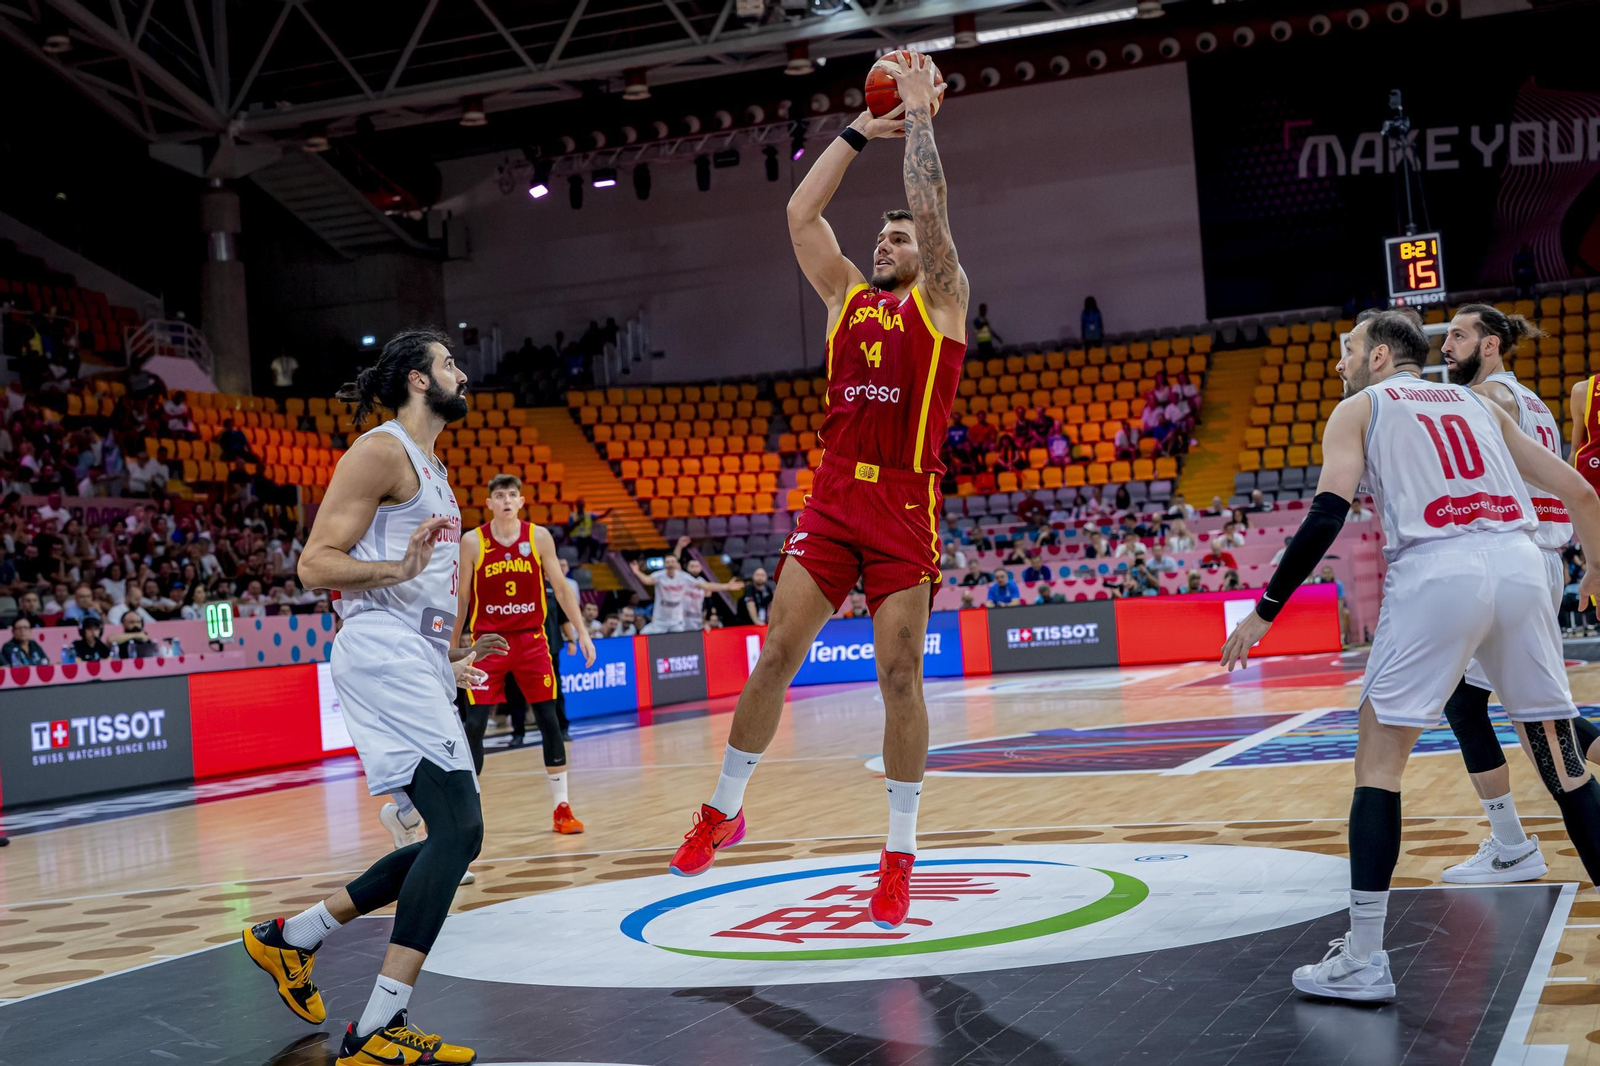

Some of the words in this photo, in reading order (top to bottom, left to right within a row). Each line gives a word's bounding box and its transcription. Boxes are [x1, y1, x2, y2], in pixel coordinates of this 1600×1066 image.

[1300, 126, 1460, 178] MAKE
[1400, 239, 1437, 260] 8:21
[1408, 259, 1437, 289] 15
[1404, 292, 1447, 306] TISSOT
[860, 341, 882, 368] 14
[1415, 413, 1485, 480] 10
[485, 557, 533, 578] ESPAÑA
[505, 581, 517, 596] 3
[485, 602, 536, 615] endesa
[206, 603, 234, 639] 00
[1032, 622, 1098, 642] TISSOT
[669, 654, 699, 673] TISSOT
[809, 640, 875, 664] Tence
[560, 667, 605, 694] encent
[70, 708, 166, 747] TISSOT
[32, 752, 65, 767] SWISS
[67, 745, 113, 762] WATCHES
[115, 742, 144, 756] SINCE
[147, 738, 168, 751] 1853
[1489, 802, 1505, 811] 23
